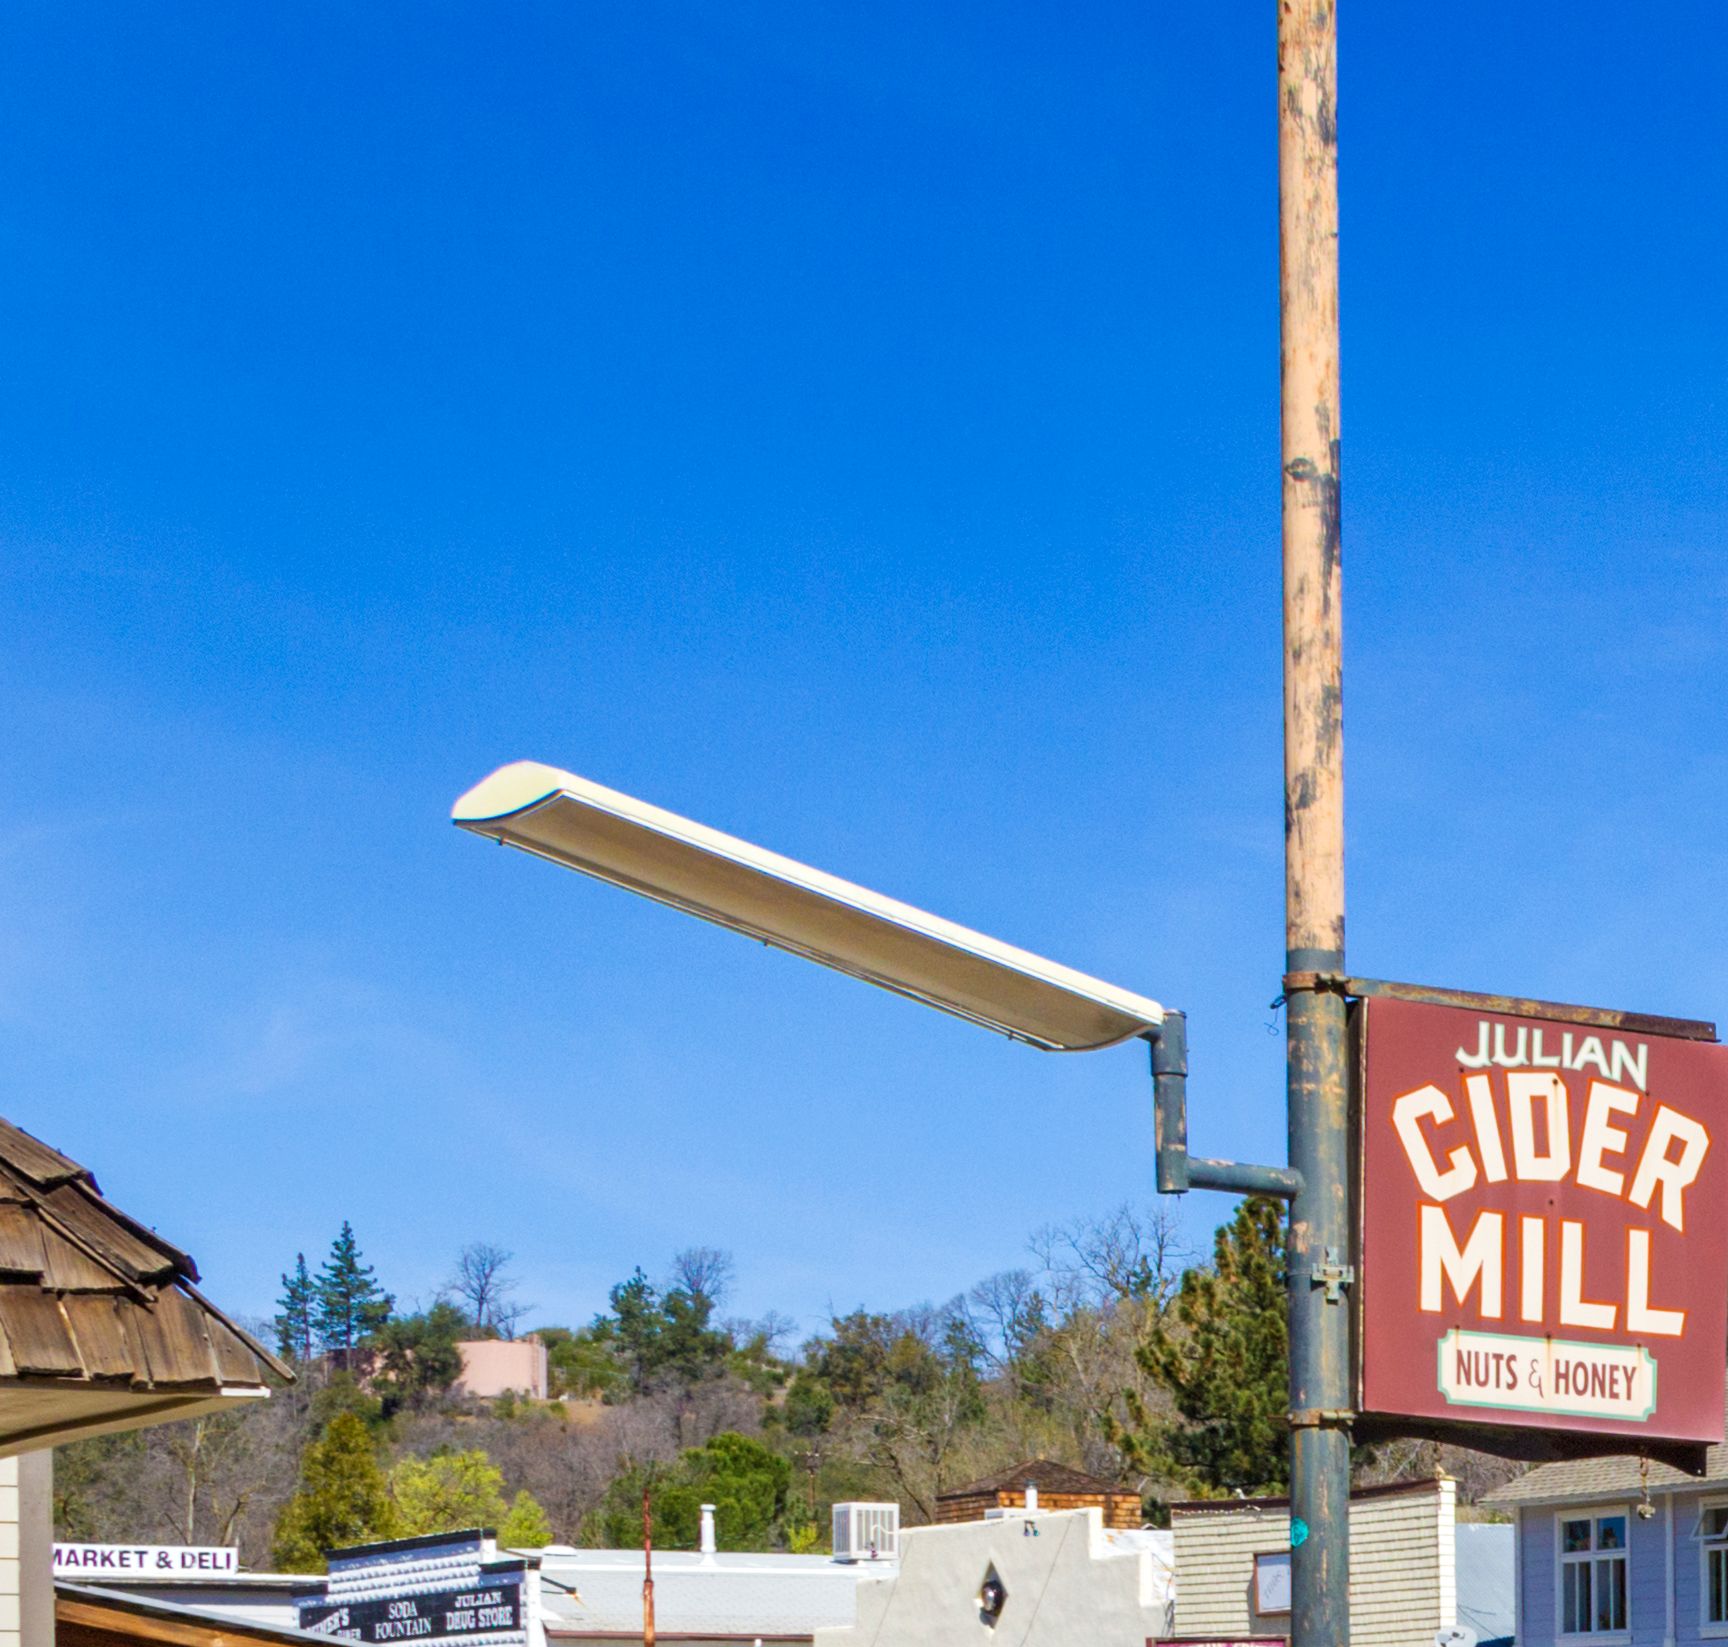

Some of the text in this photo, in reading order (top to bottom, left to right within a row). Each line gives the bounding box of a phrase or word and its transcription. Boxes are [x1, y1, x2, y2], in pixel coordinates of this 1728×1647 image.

[1455, 1020, 1649, 1093] JULIAN
[1391, 1070, 1712, 1236] CIDER
[1416, 1200, 1689, 1338] MILL
[1456, 1349, 1637, 1401] NUTS & HONEY
[156, 1550, 174, 1570] &
[181, 1551, 232, 1571] DELI
[389, 1600, 418, 1620] SODA
[455, 1592, 503, 1608] JULIAN
[375, 1617, 433, 1640] FOUNTAIN
[446, 1606, 514, 1631] DRUG STORE
